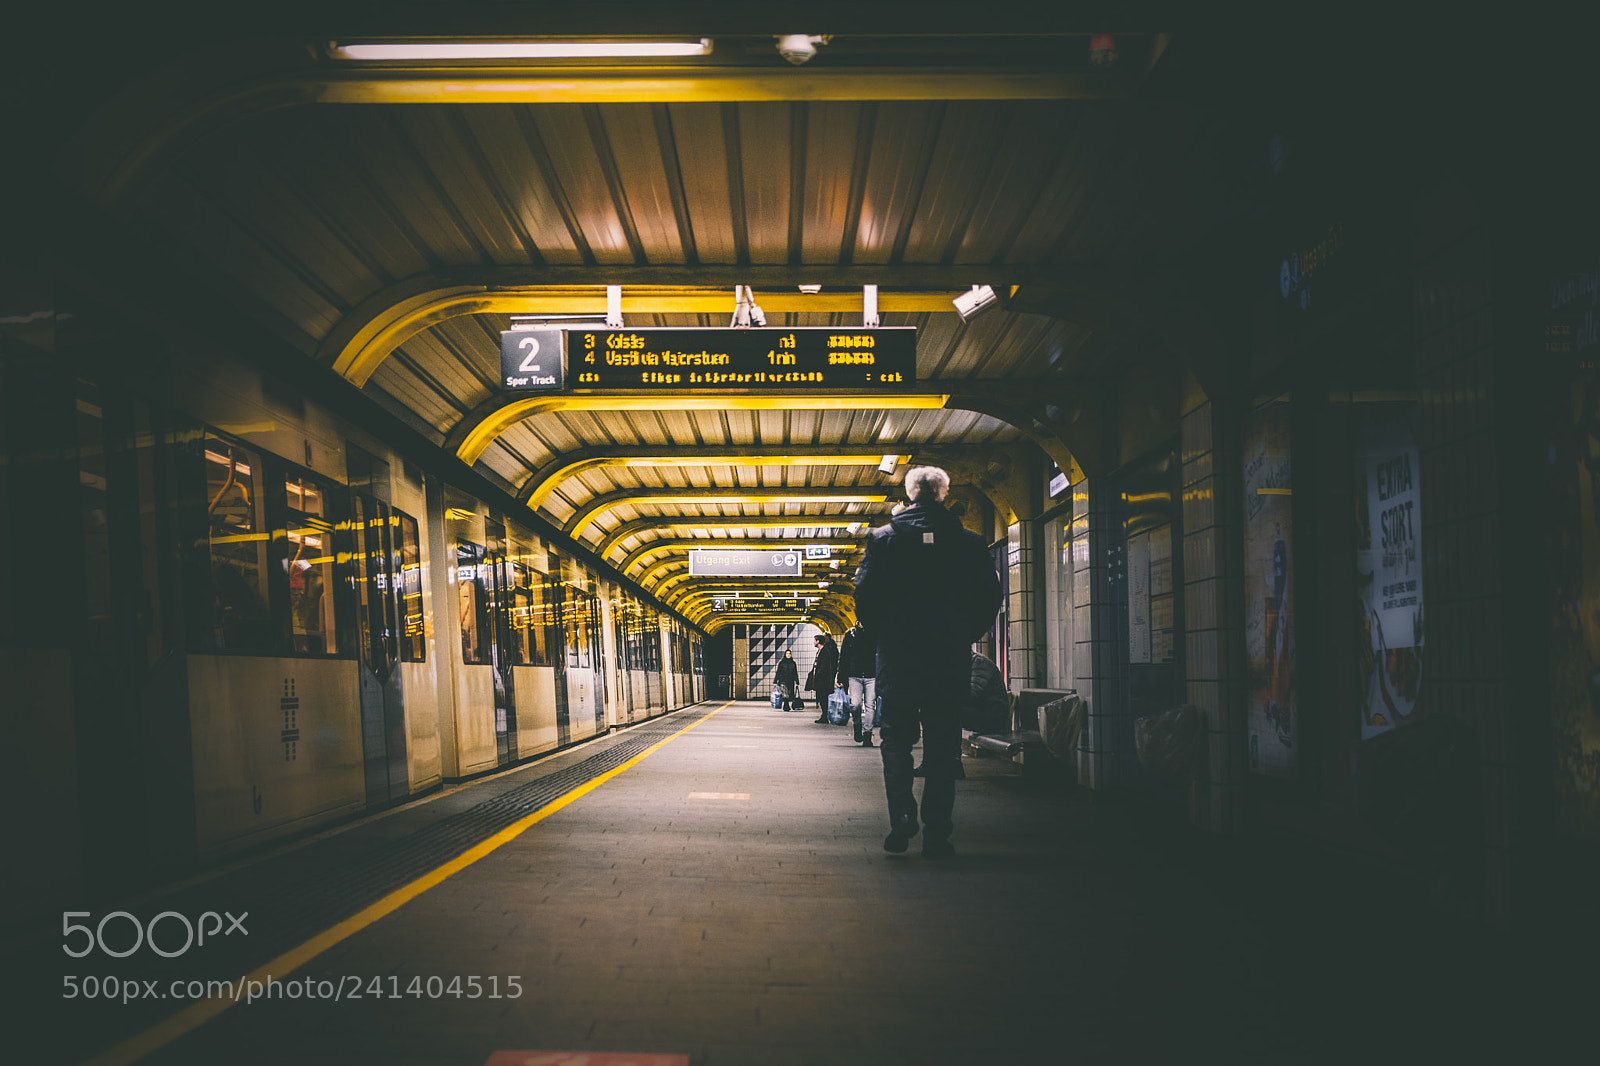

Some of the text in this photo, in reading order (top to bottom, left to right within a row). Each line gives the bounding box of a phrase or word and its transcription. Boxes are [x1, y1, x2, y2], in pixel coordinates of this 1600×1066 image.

[583, 333, 596, 349] 3
[518, 337, 541, 372] 2
[583, 350, 596, 365] 4
[506, 375, 556, 388] Spor Track
[1376, 451, 1413, 501] EXTRA
[696, 555, 751, 566] Utgang Exit
[714, 599, 721, 609] 2
